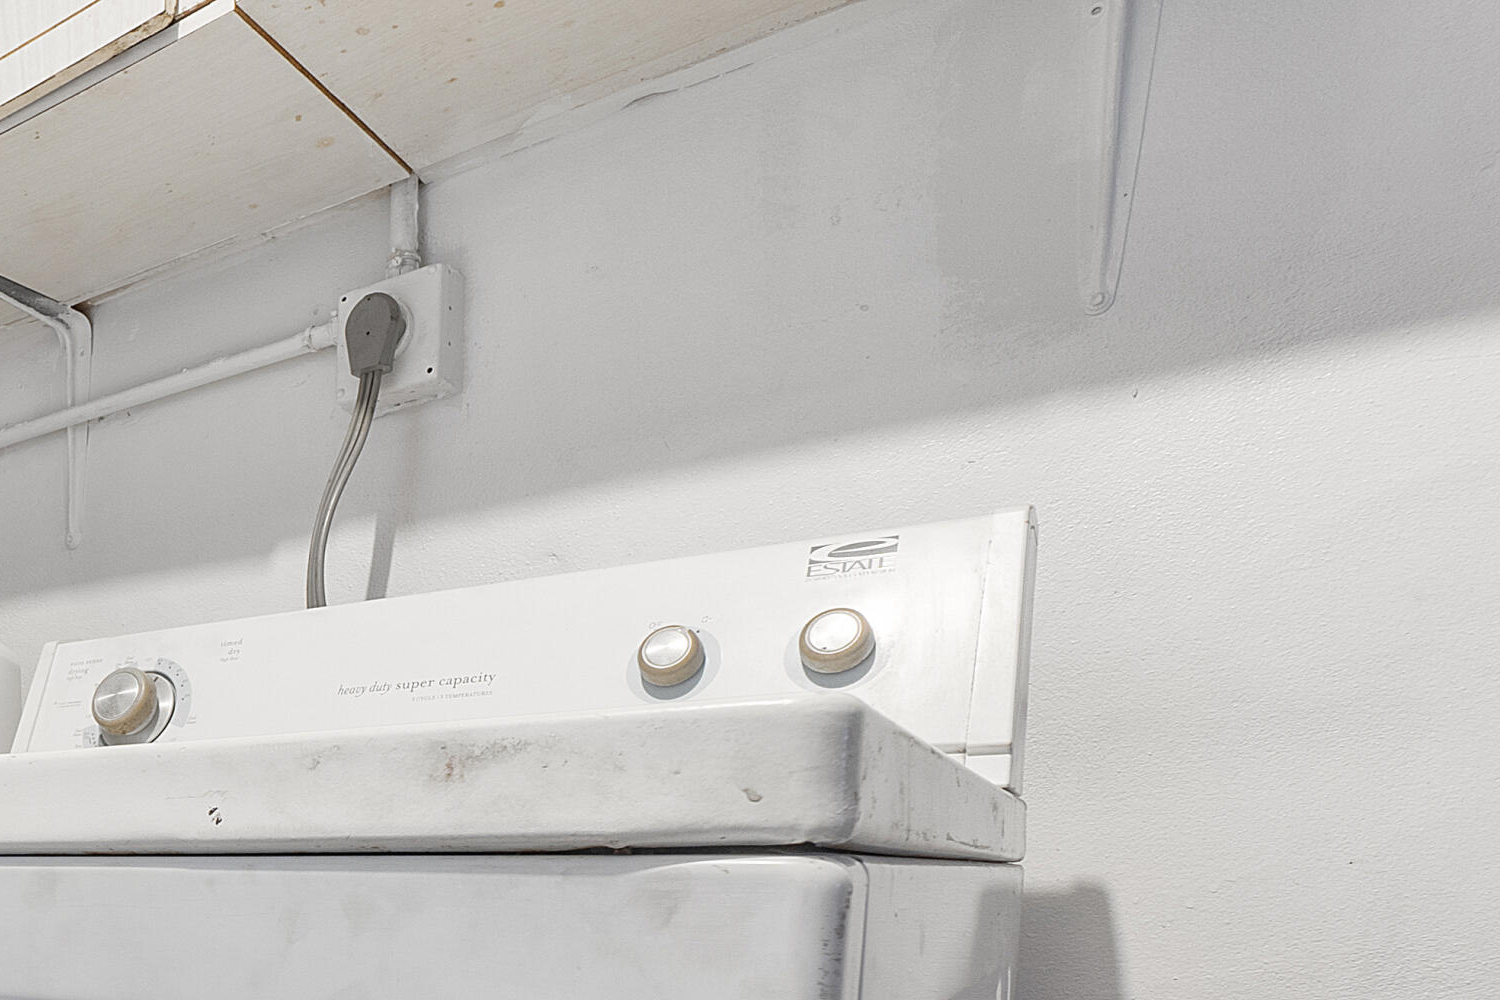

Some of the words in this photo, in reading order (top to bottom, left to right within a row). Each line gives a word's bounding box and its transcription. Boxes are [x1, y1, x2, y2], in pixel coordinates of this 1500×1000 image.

[337, 684, 367, 698] heavy
[369, 681, 392, 695] duty
[395, 679, 435, 692] super
[438, 672, 497, 688] capacity
